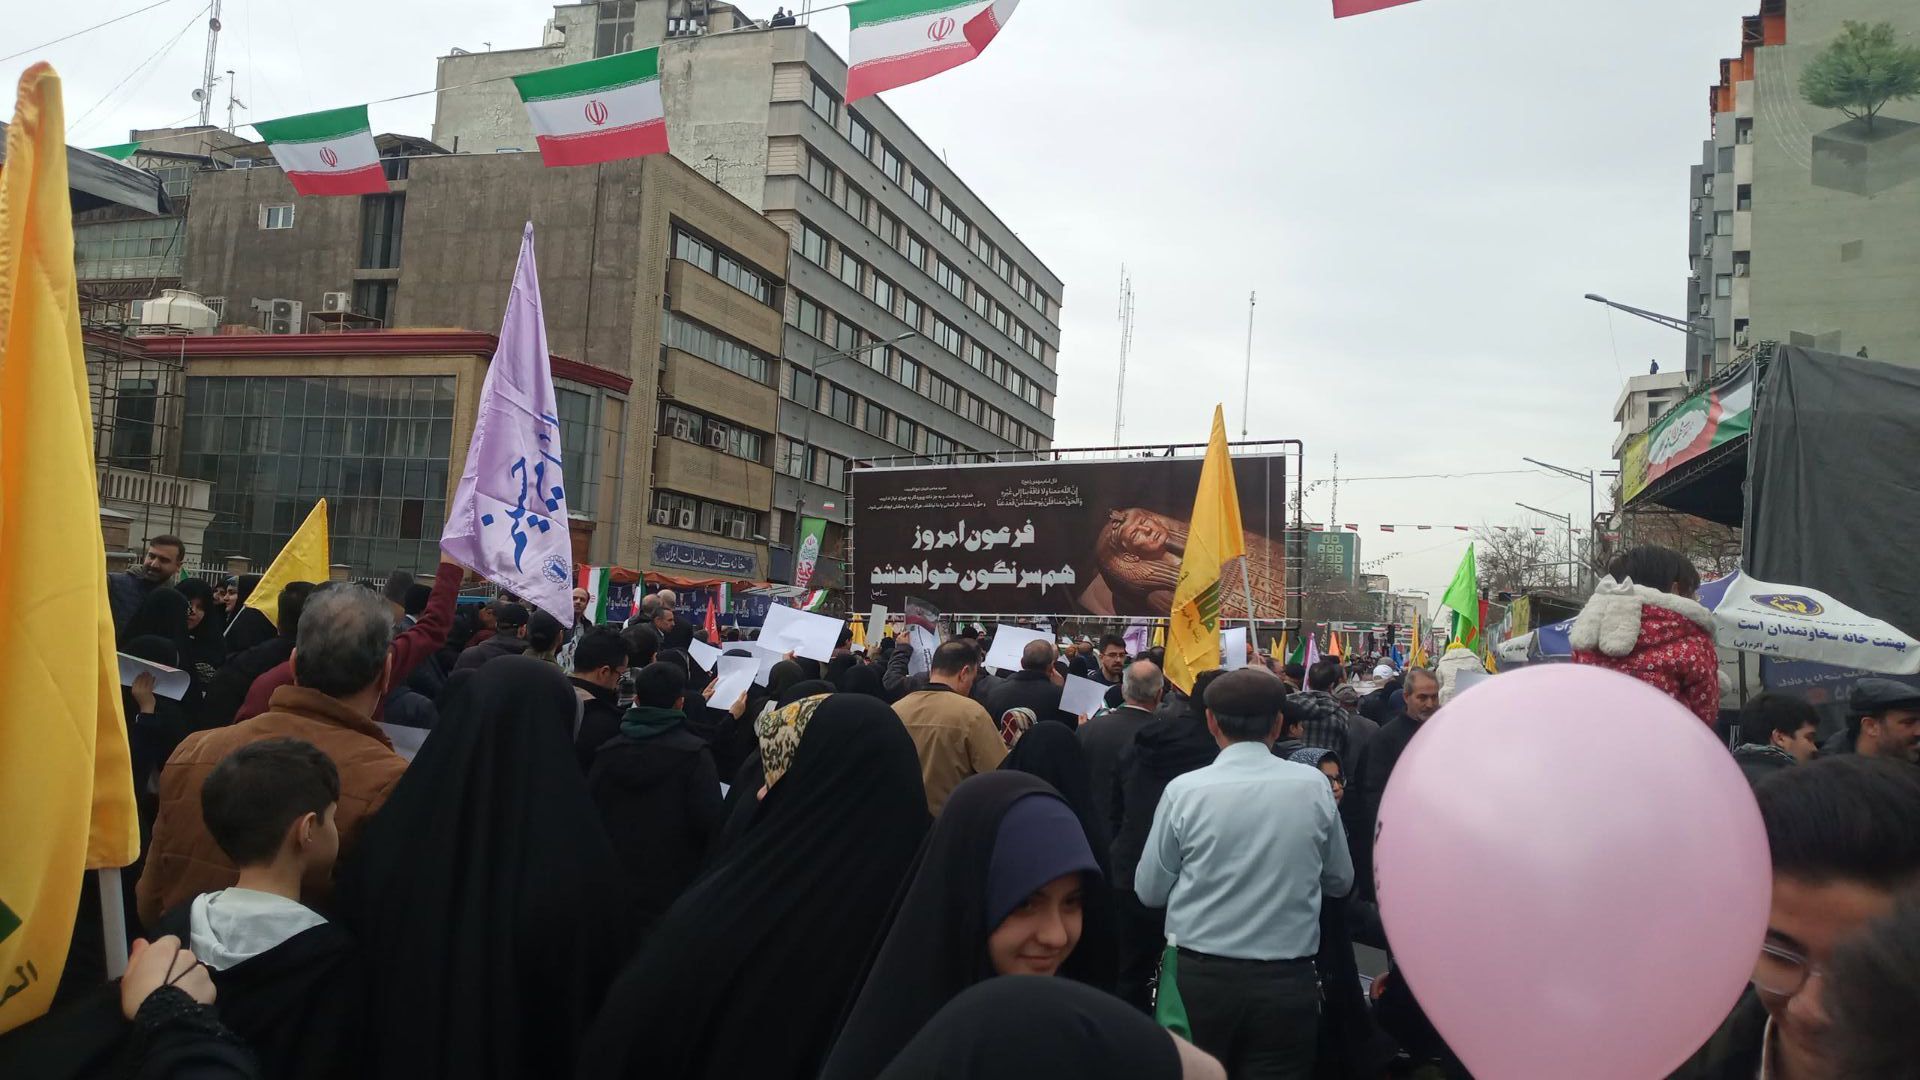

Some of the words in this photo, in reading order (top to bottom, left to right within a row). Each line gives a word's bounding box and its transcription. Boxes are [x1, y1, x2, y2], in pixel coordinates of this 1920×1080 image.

[912, 519, 965, 550] امروز
[964, 518, 1035, 552] فرعون
[664, 545, 679, 562] ایران
[870, 563, 896, 584] شد
[895, 559, 960, 590] خواهد
[1041, 563, 1076, 596] هم
[1737, 619, 1763, 631] است
[1767, 623, 1839, 642] سخاوتمندان
[1842, 632, 1869, 643] خانه
[1872, 637, 1907, 652] بهشت
